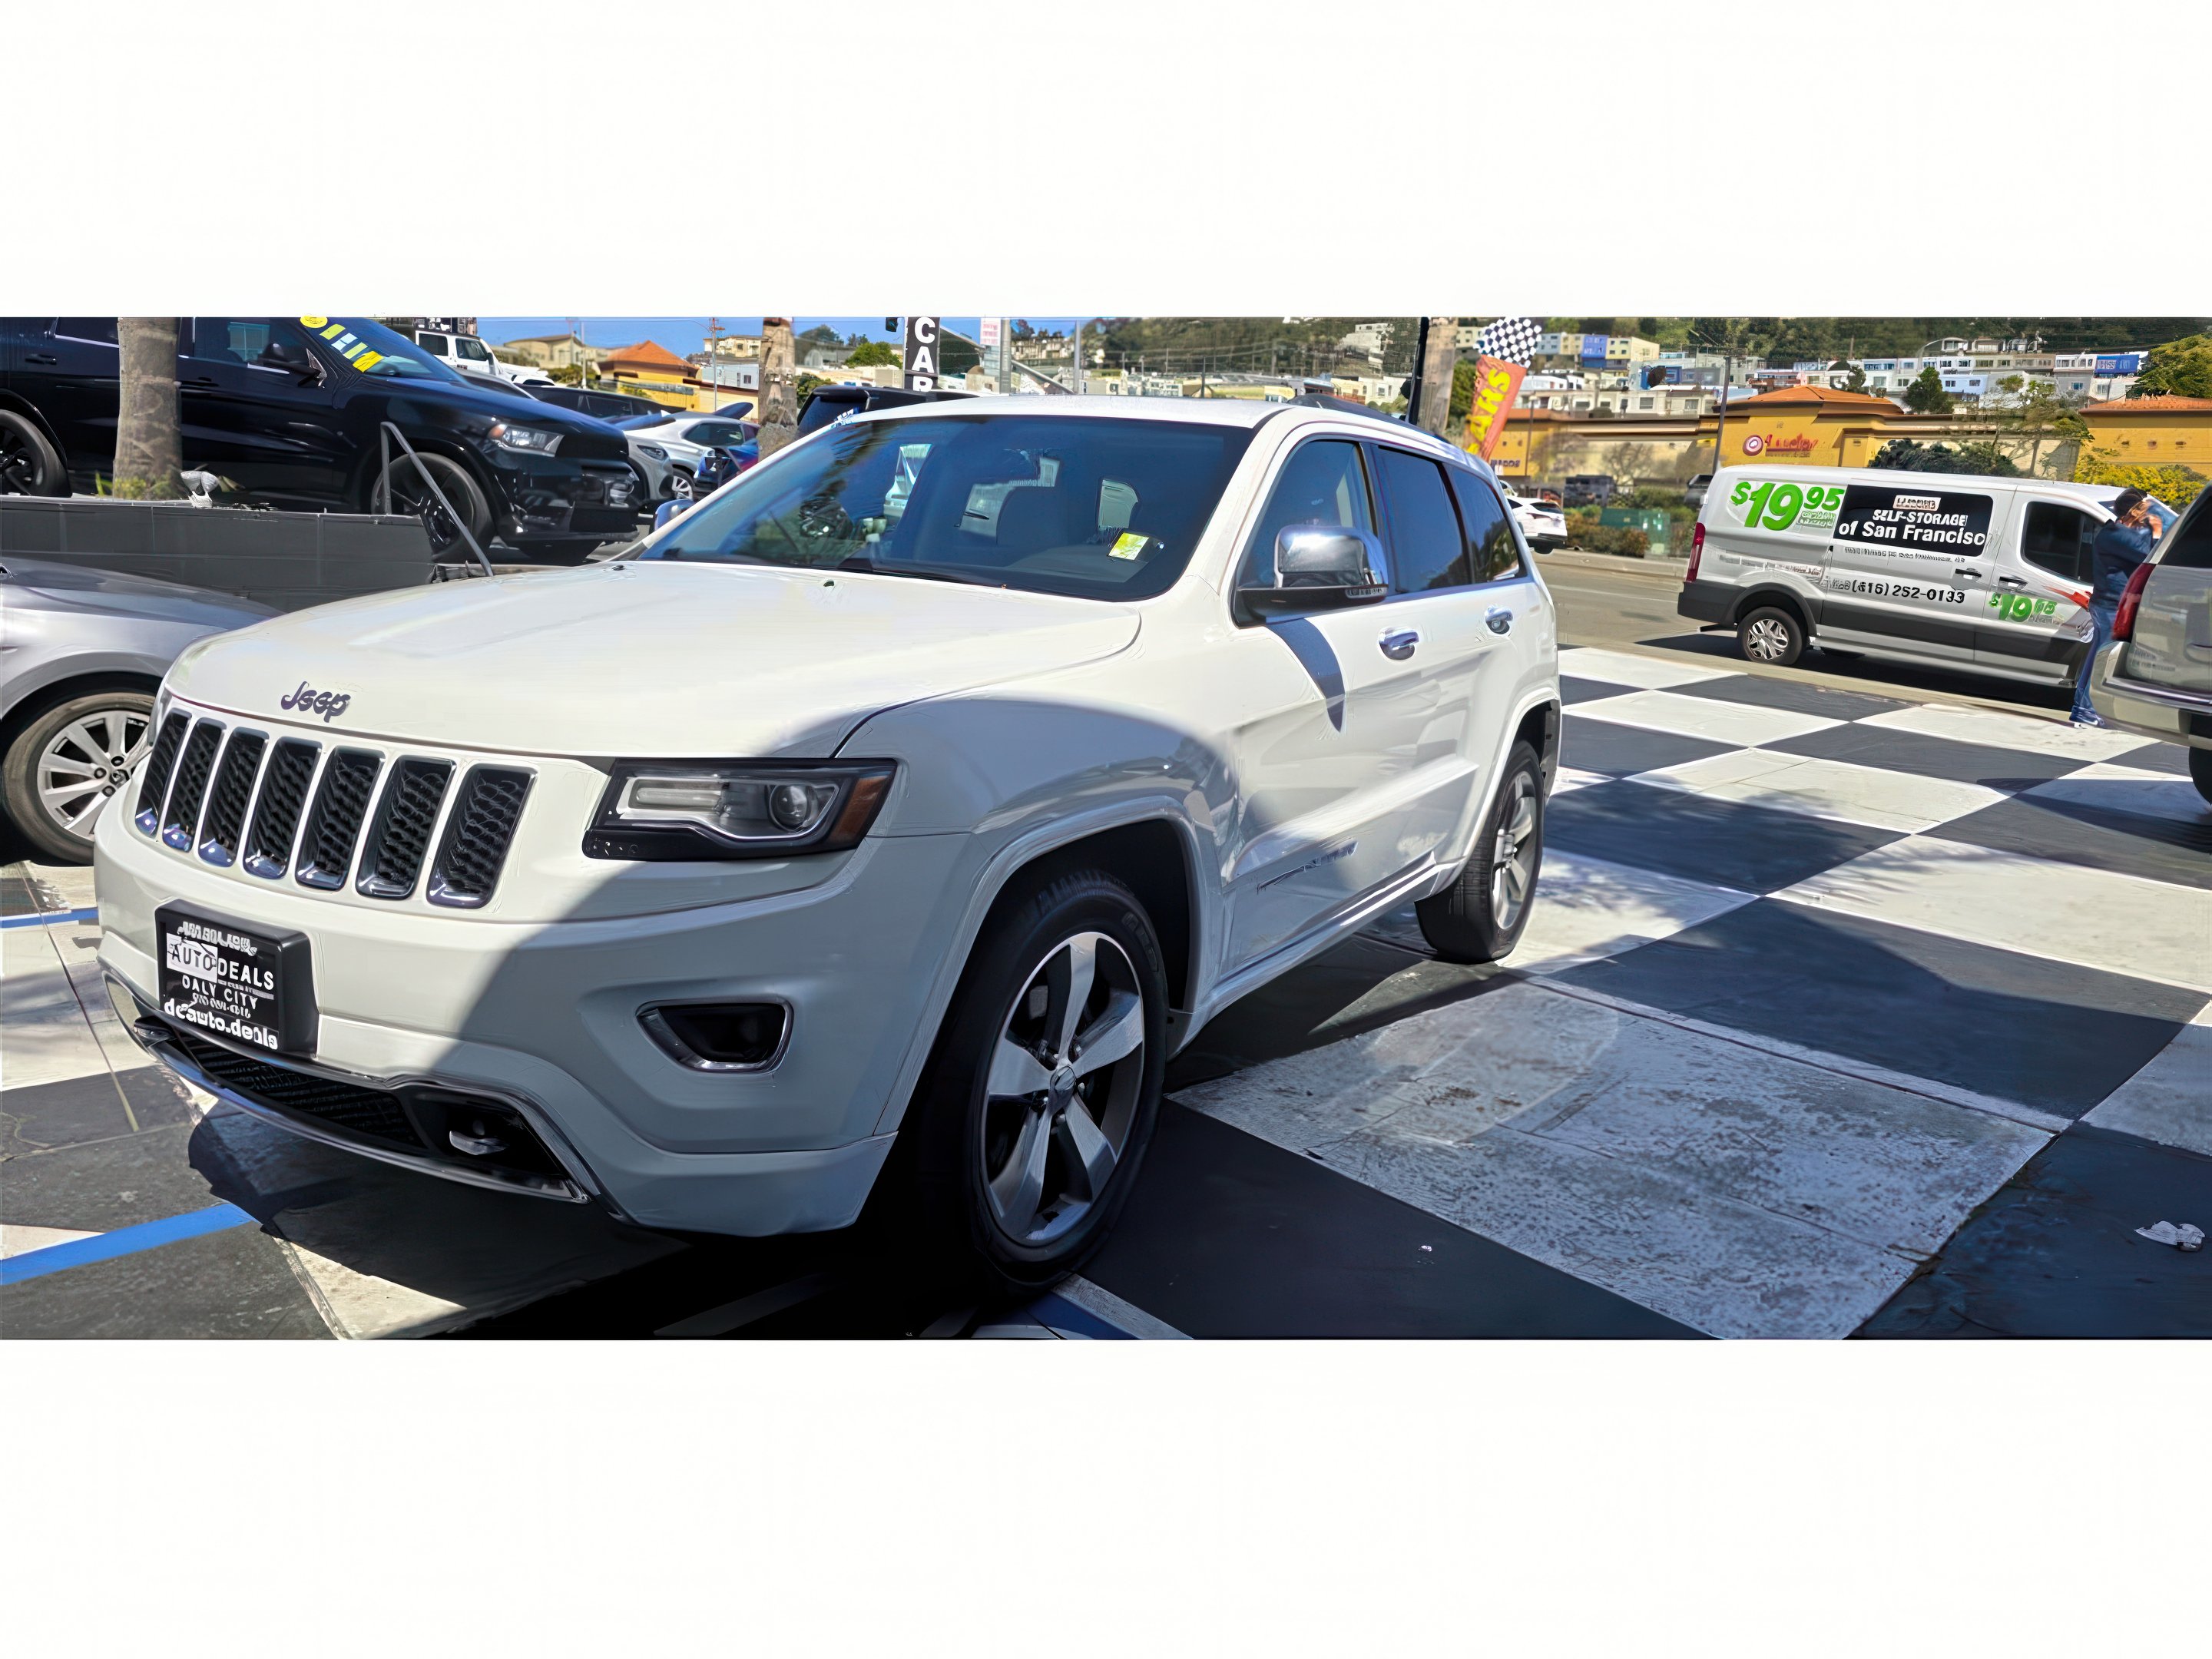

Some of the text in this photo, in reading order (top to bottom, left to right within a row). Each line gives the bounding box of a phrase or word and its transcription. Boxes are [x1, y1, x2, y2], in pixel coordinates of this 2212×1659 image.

[1839, 521, 1858, 535] of
[1862, 521, 1897, 538] San
[281, 681, 351, 723] Jeep
[171, 944, 214, 972] AUTO
[217, 957, 274, 990] DEALS
[224, 988, 258, 1010] CITY
